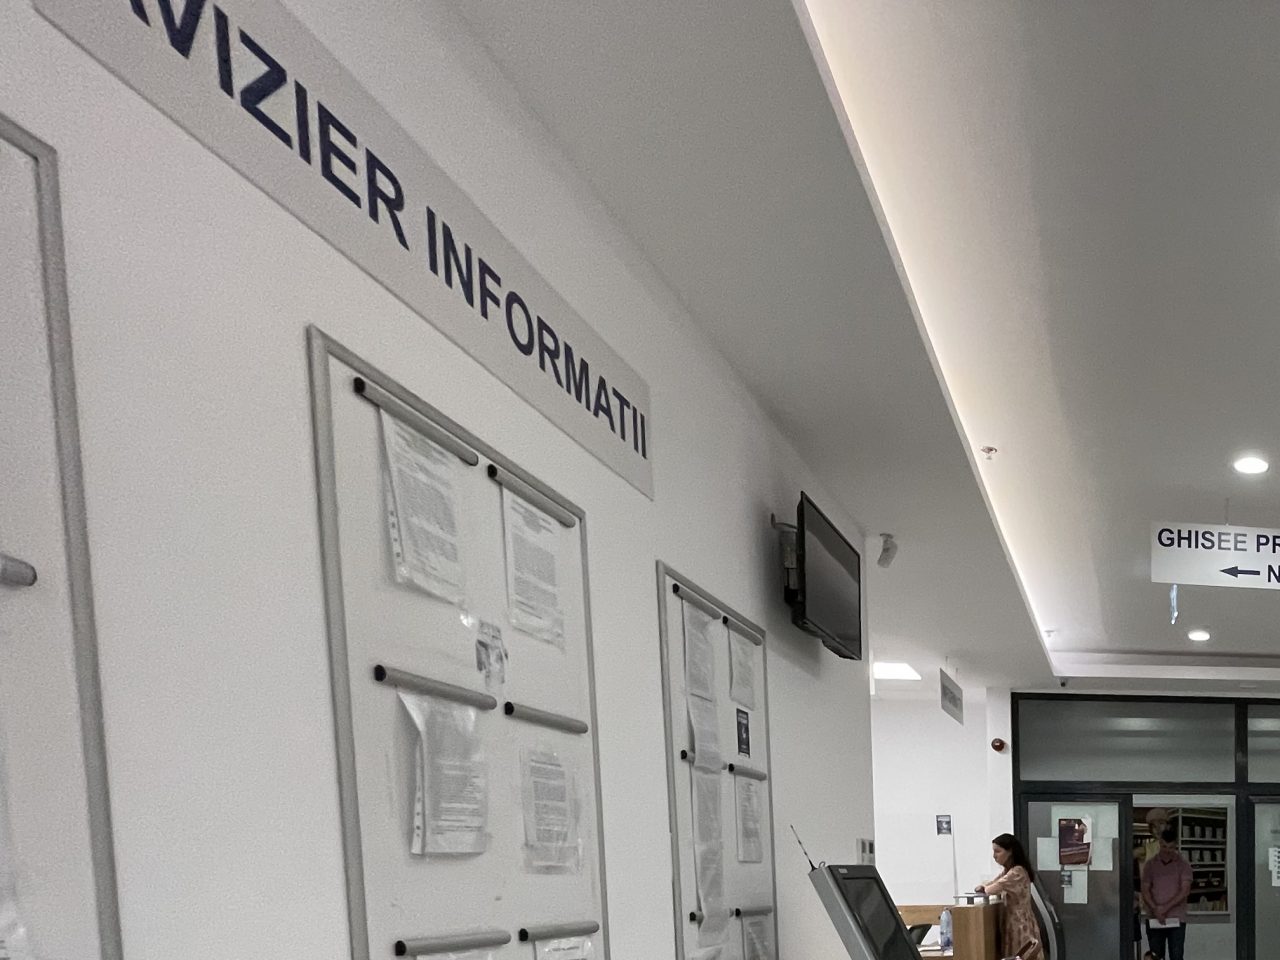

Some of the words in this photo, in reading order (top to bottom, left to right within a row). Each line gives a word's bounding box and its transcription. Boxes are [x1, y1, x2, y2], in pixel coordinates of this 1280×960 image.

[130, 0, 409, 251] VIZIER
[426, 207, 648, 460] INFORMATII
[1157, 528, 1247, 552] GHISEE
